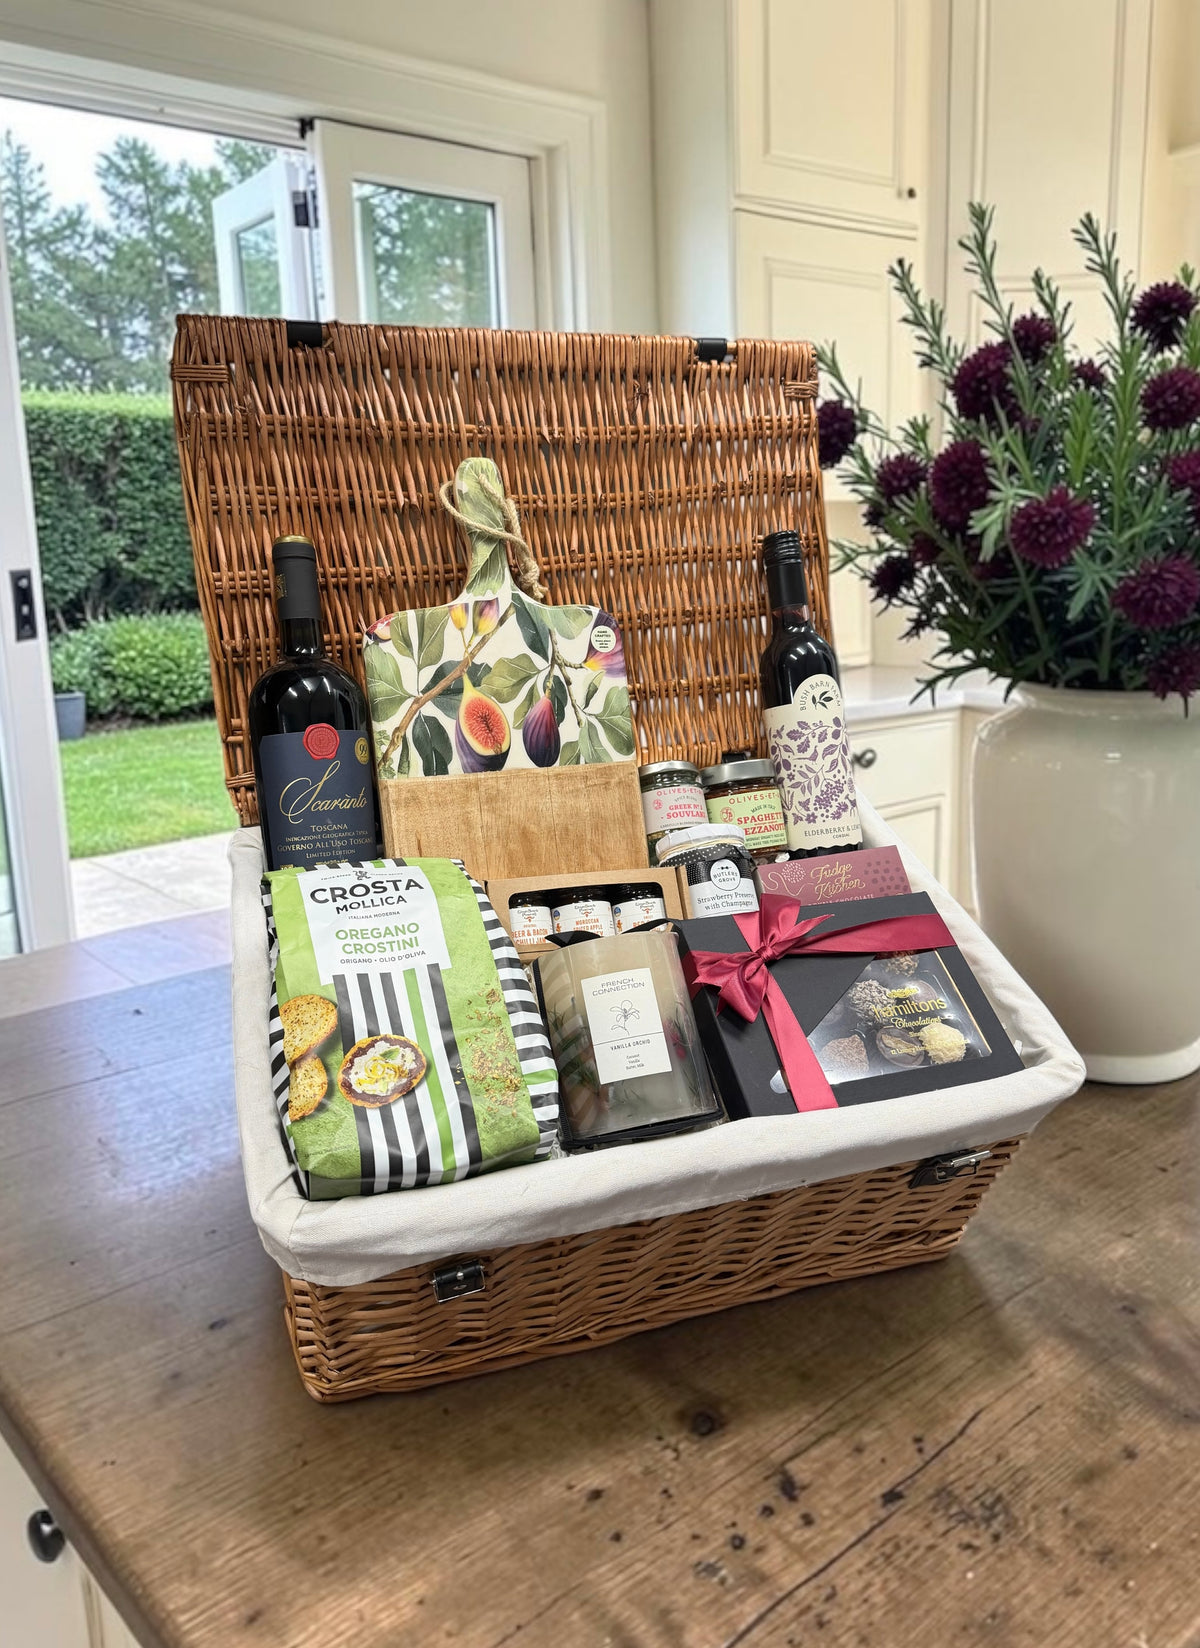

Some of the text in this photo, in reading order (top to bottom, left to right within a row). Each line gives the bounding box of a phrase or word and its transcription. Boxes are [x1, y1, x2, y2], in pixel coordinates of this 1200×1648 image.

[800, 689, 810, 711] BUSH
[809, 681, 829, 690] BARN
[279, 760, 368, 824] Scarànto
[668, 803, 693, 811] GREEK
[310, 823, 348, 832] TOSCANA
[804, 827, 845, 837] ELDERBERRY
[285, 835, 320, 843] INDICAZIONE
[277, 843, 313, 852] GOVERNO
[306, 851, 331, 859] LIMITED
[712, 871, 738, 879] BUTLERS
[810, 861, 852, 883] Fudge
[310, 879, 425, 904] CROSTA
[815, 874, 866, 900] Kitchen
[697, 894, 733, 904] Strawberry
[335, 895, 407, 915] MOLLICA
[704, 902, 721, 910] with
[373, 910, 400, 918] MODERNA
[335, 922, 420, 940] OREGANO
[341, 936, 419, 954] CROSTINI
[340, 957, 373, 965] ORIGANO
[397, 950, 426, 961] D'OLIVA
[600, 977, 634, 988] FRENCH
[592, 982, 645, 996] CONNECTION
[872, 998, 947, 1020] hamiltons
[610, 1043, 631, 1051] VANILLA
